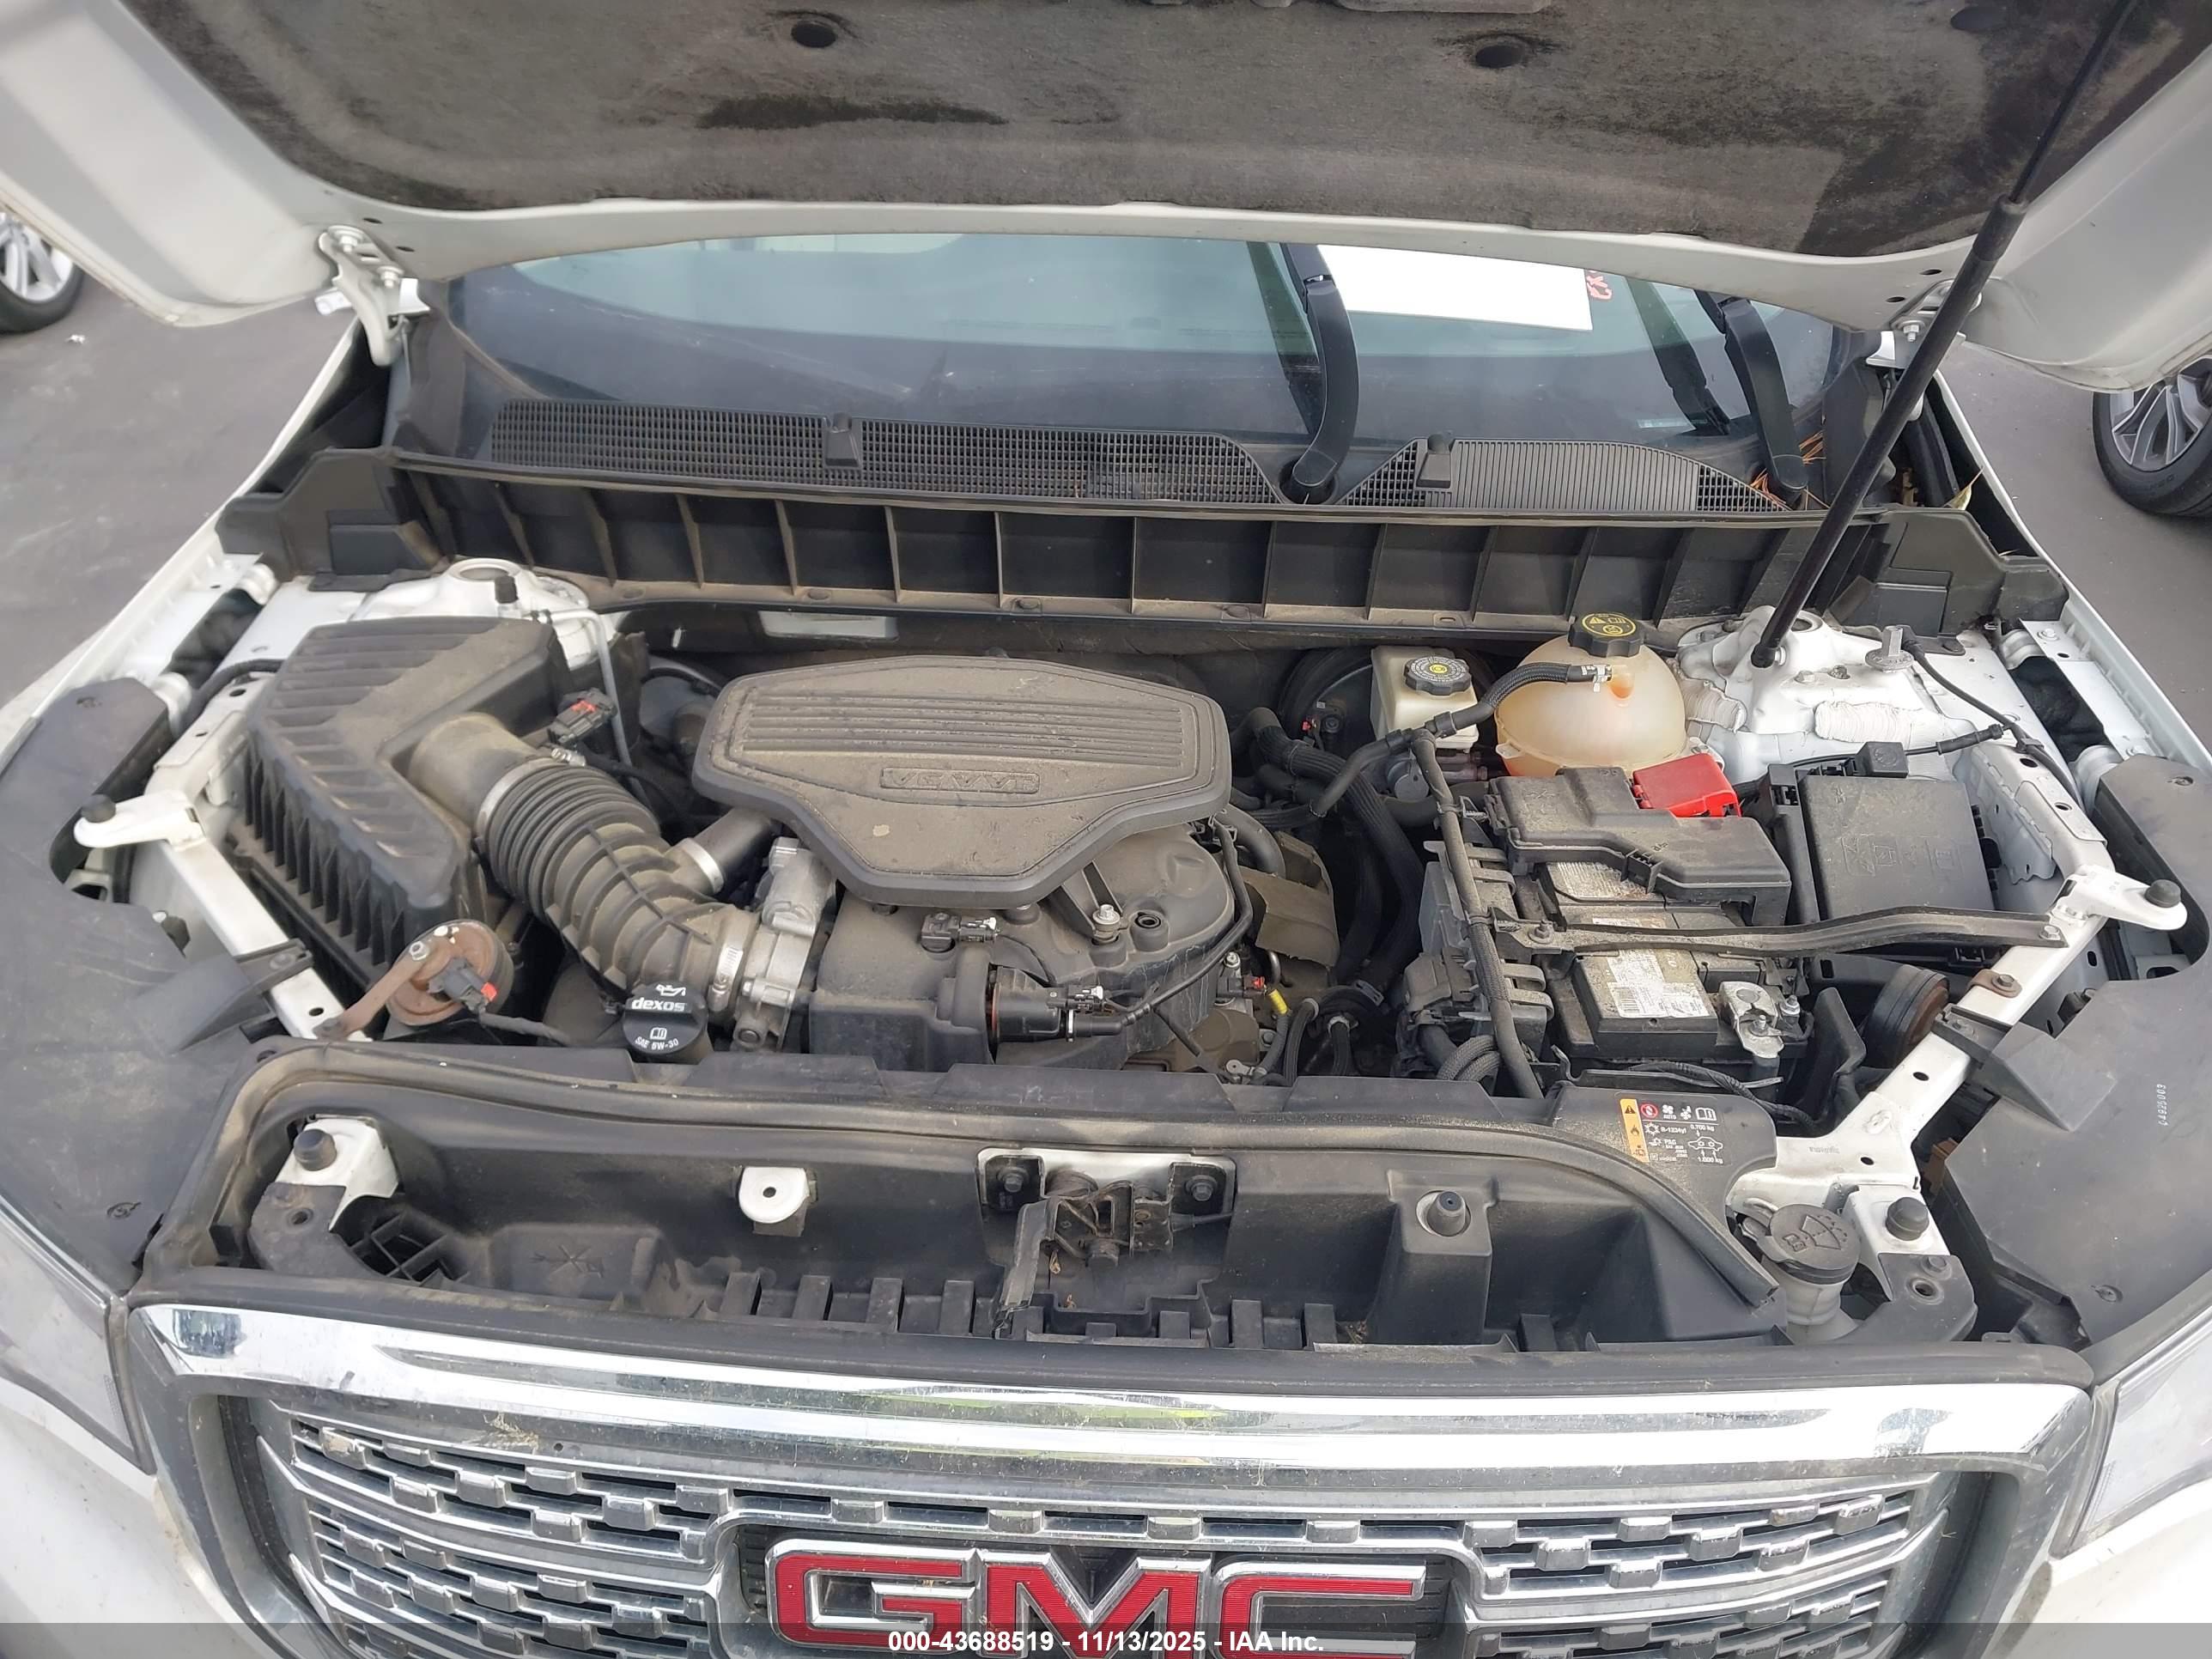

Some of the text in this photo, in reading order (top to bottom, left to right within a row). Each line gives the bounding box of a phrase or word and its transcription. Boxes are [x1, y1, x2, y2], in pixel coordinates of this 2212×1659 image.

[631, 997, 687, 1012] dexos
[635, 1036, 679, 1050] SAE 5W-30
[764, 1538, 1426, 1659] GMC
